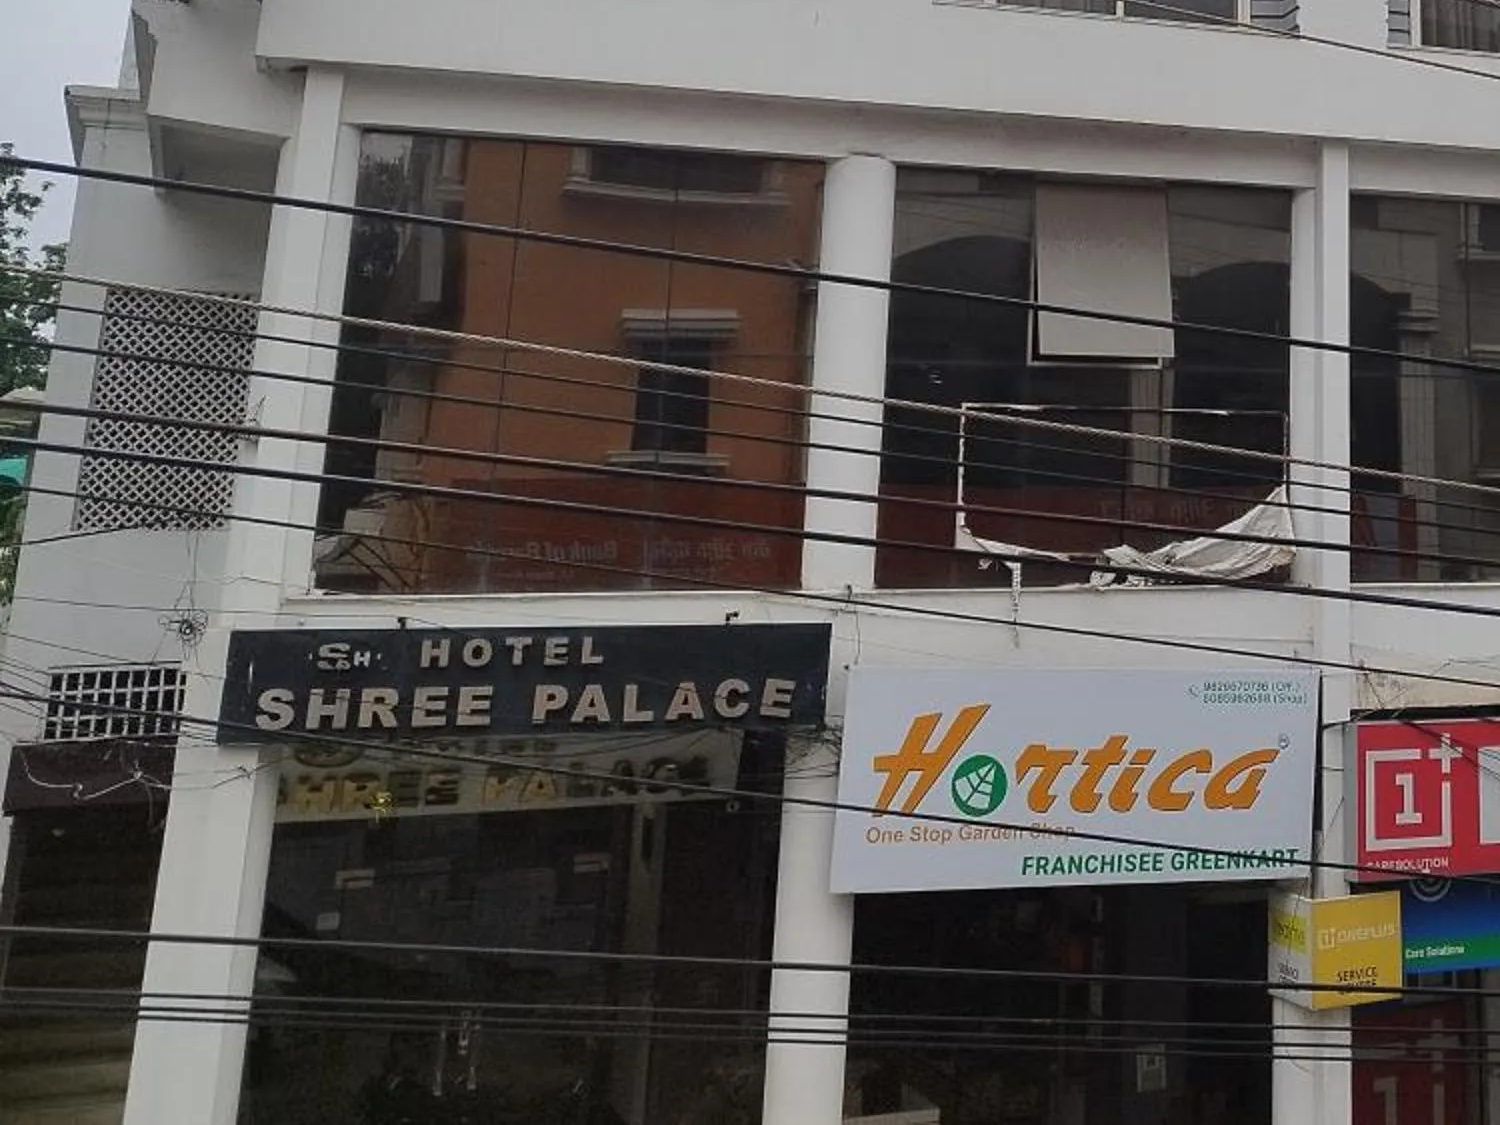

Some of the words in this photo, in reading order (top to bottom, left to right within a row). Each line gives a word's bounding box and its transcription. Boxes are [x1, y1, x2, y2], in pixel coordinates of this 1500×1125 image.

[420, 636, 604, 668] HOTEL
[255, 684, 494, 730] SHREE
[531, 678, 797, 723] PALACE
[278, 773, 459, 811] HREE
[866, 826, 904, 845] One
[909, 825, 953, 846] Stop
[959, 822, 1024, 841] Garden
[1021, 852, 1165, 876] FRANCHISEE
[1170, 848, 1300, 871] GREENKART
[1337, 966, 1377, 983] SERVICE
